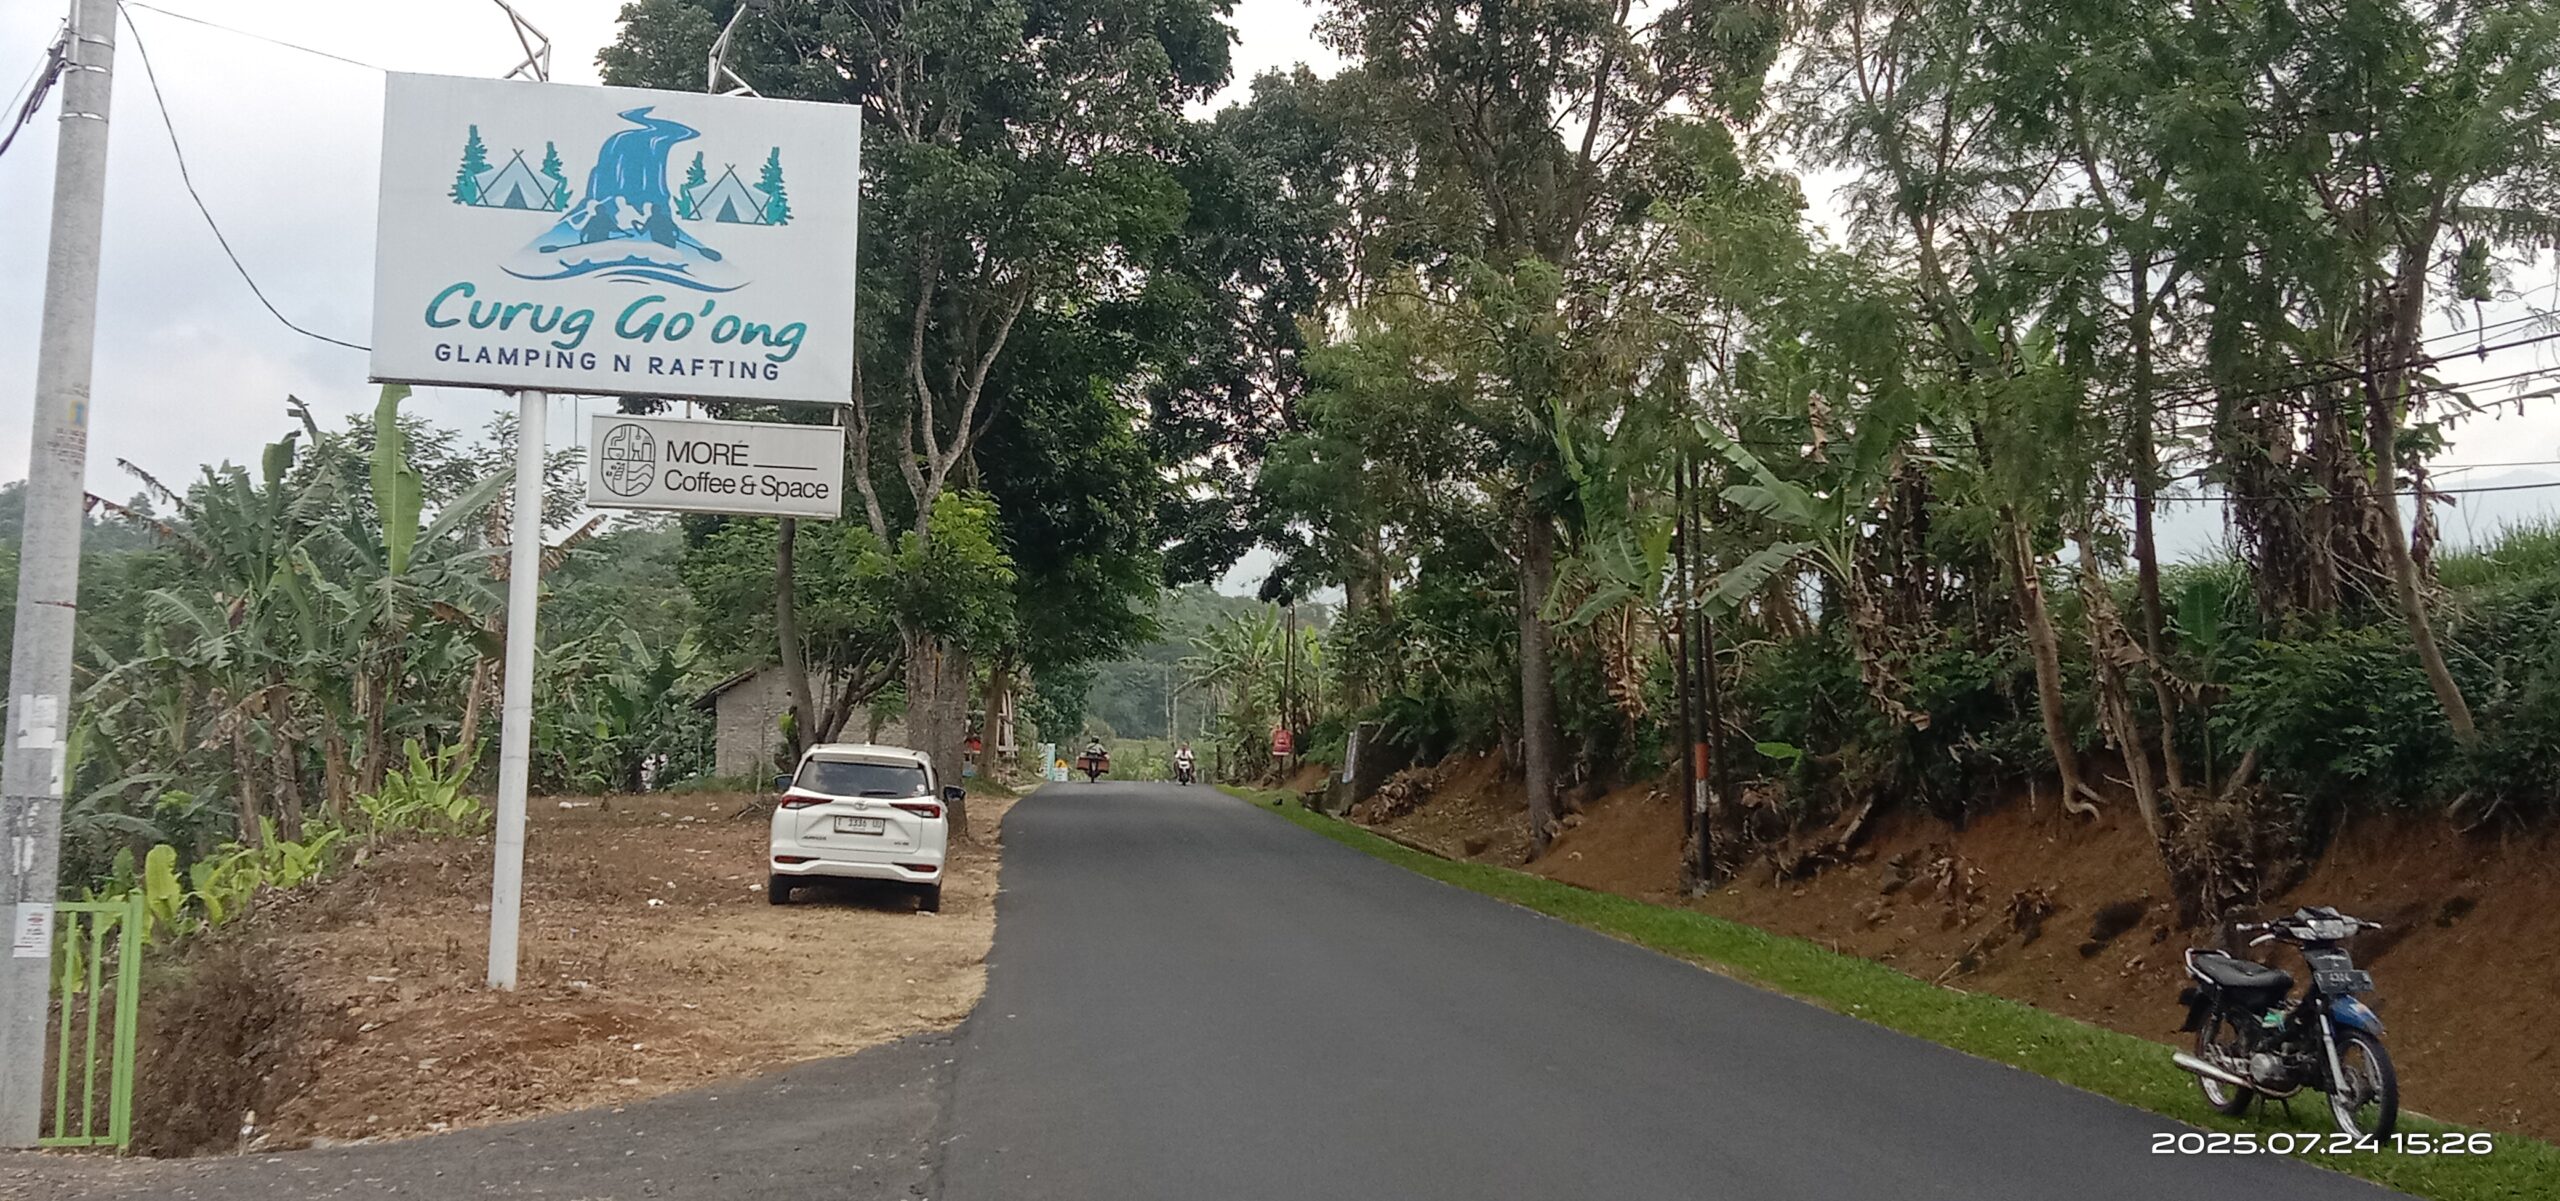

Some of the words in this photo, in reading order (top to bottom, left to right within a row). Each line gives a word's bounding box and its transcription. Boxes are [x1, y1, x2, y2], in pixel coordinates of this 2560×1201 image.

[425, 281, 595, 351] Curug
[614, 294, 808, 363] Go'ong
[434, 343, 597, 371] GLAMPING
[613, 354, 631, 373] N
[648, 356, 779, 381] RAFTING
[664, 469, 736, 494] Coffee
[740, 475, 758, 496] &
[760, 475, 829, 502] Space
